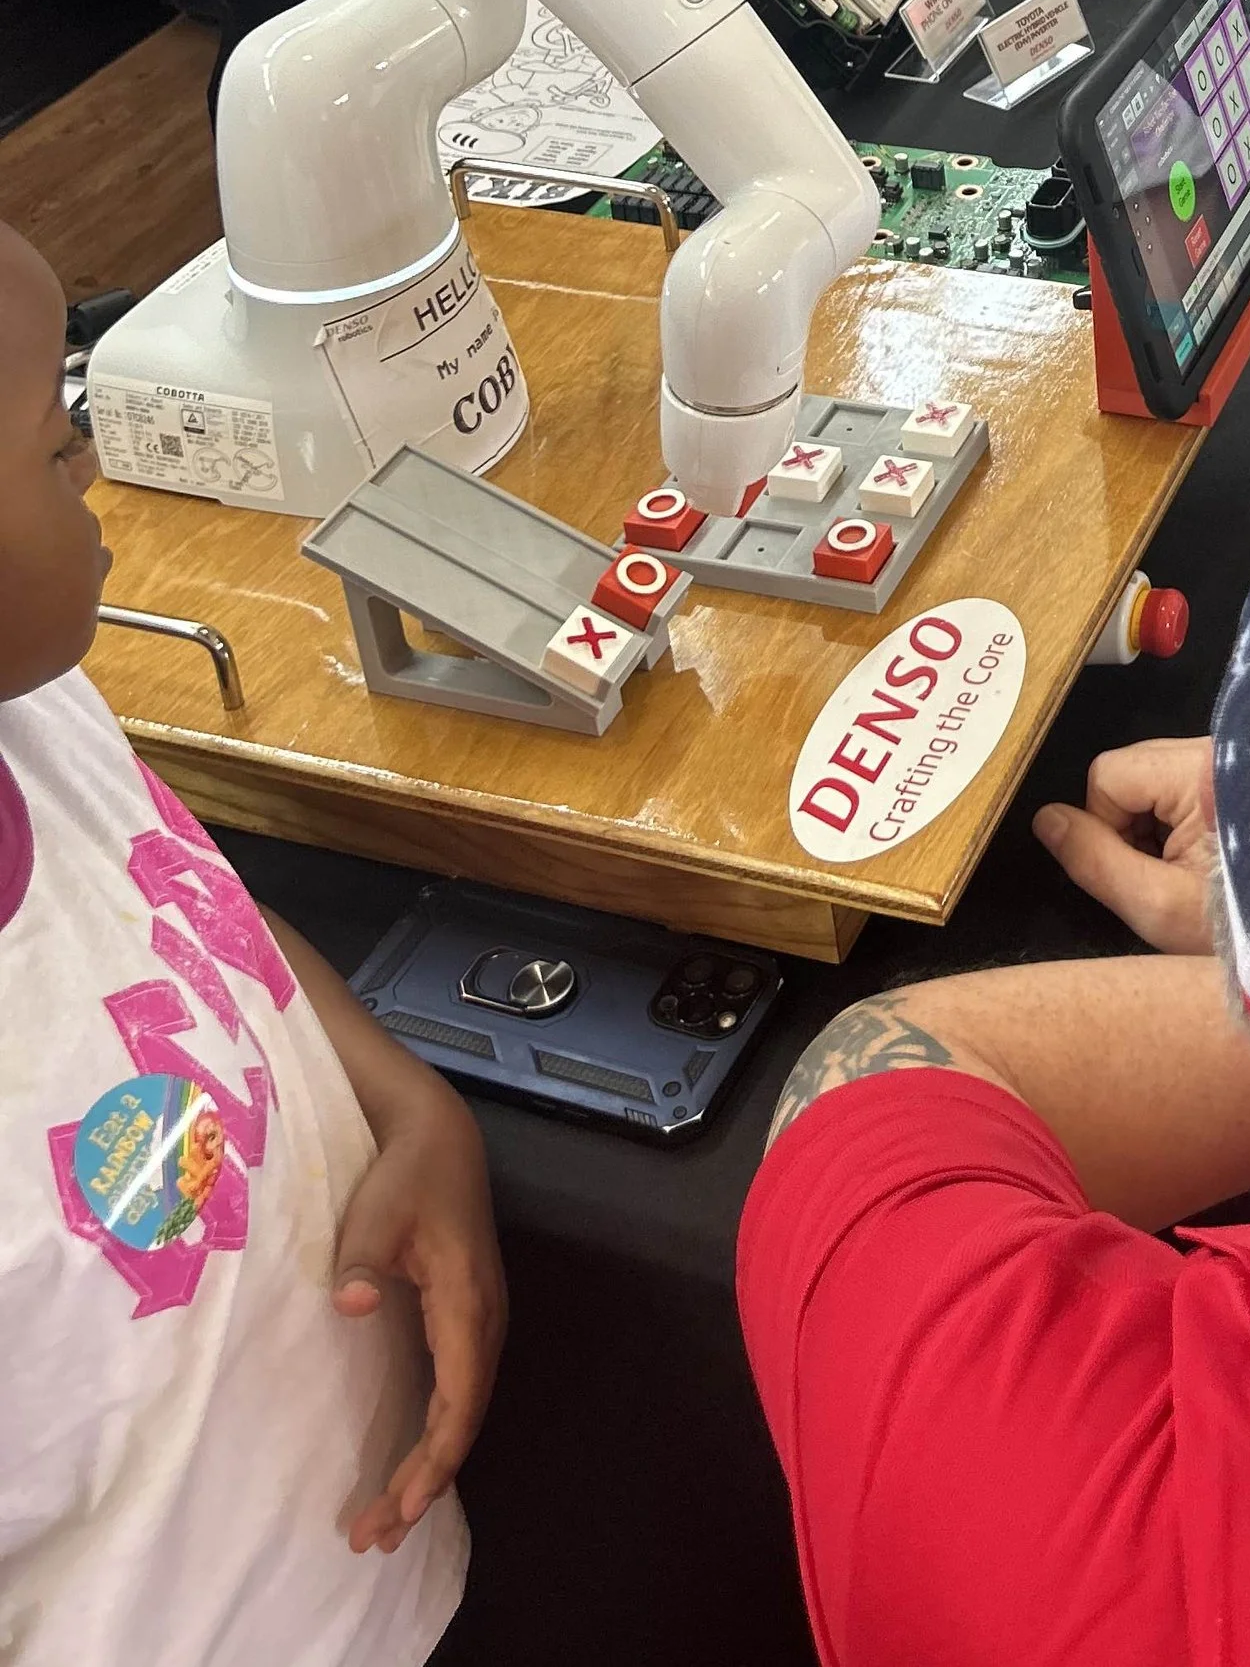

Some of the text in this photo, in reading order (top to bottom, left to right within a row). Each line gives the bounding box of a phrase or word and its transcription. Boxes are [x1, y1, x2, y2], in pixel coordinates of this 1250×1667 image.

[921, 7, 944, 32] PHONE
[996, 29, 1026, 52] ELECTRIC
[1022, 15, 1046, 38] HYBRID
[1042, 1, 1070, 23] VEHICLE
[1015, 6, 1045, 29] TOYOTA
[1029, 18, 1059, 43] INVERTER
[1029, 36, 1054, 56] DENSO
[337, 324, 374, 343] robotics
[436, 323, 494, 381] My name
[156, 386, 205, 402] COBOTTA
[453, 344, 517, 435] COB
[797, 617, 963, 834] DENSO
[869, 633, 1014, 843] Crafting the Core
[88, 1093, 143, 1151] Eat a
[90, 1110, 154, 1195] RAINBOW
